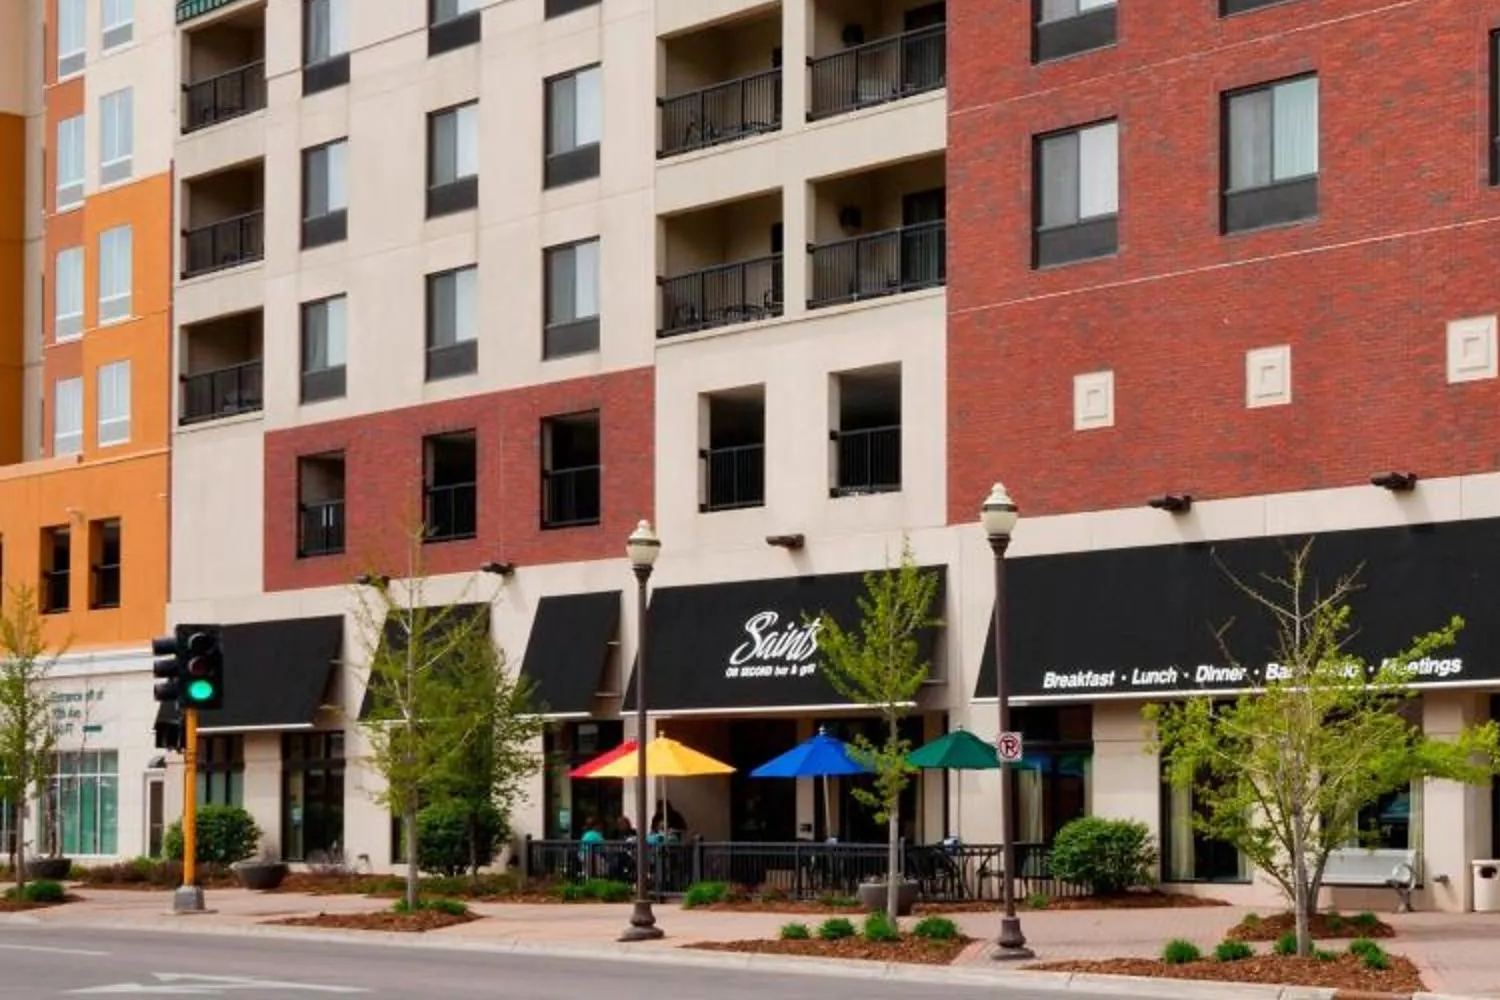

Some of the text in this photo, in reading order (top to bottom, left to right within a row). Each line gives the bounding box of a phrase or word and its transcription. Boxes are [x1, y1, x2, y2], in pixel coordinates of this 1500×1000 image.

[729, 611, 821, 665] Saints
[1043, 671, 1115, 689] Breakfast
[1131, 667, 1178, 685] Lunch
[1195, 664, 1248, 683] Dinner
